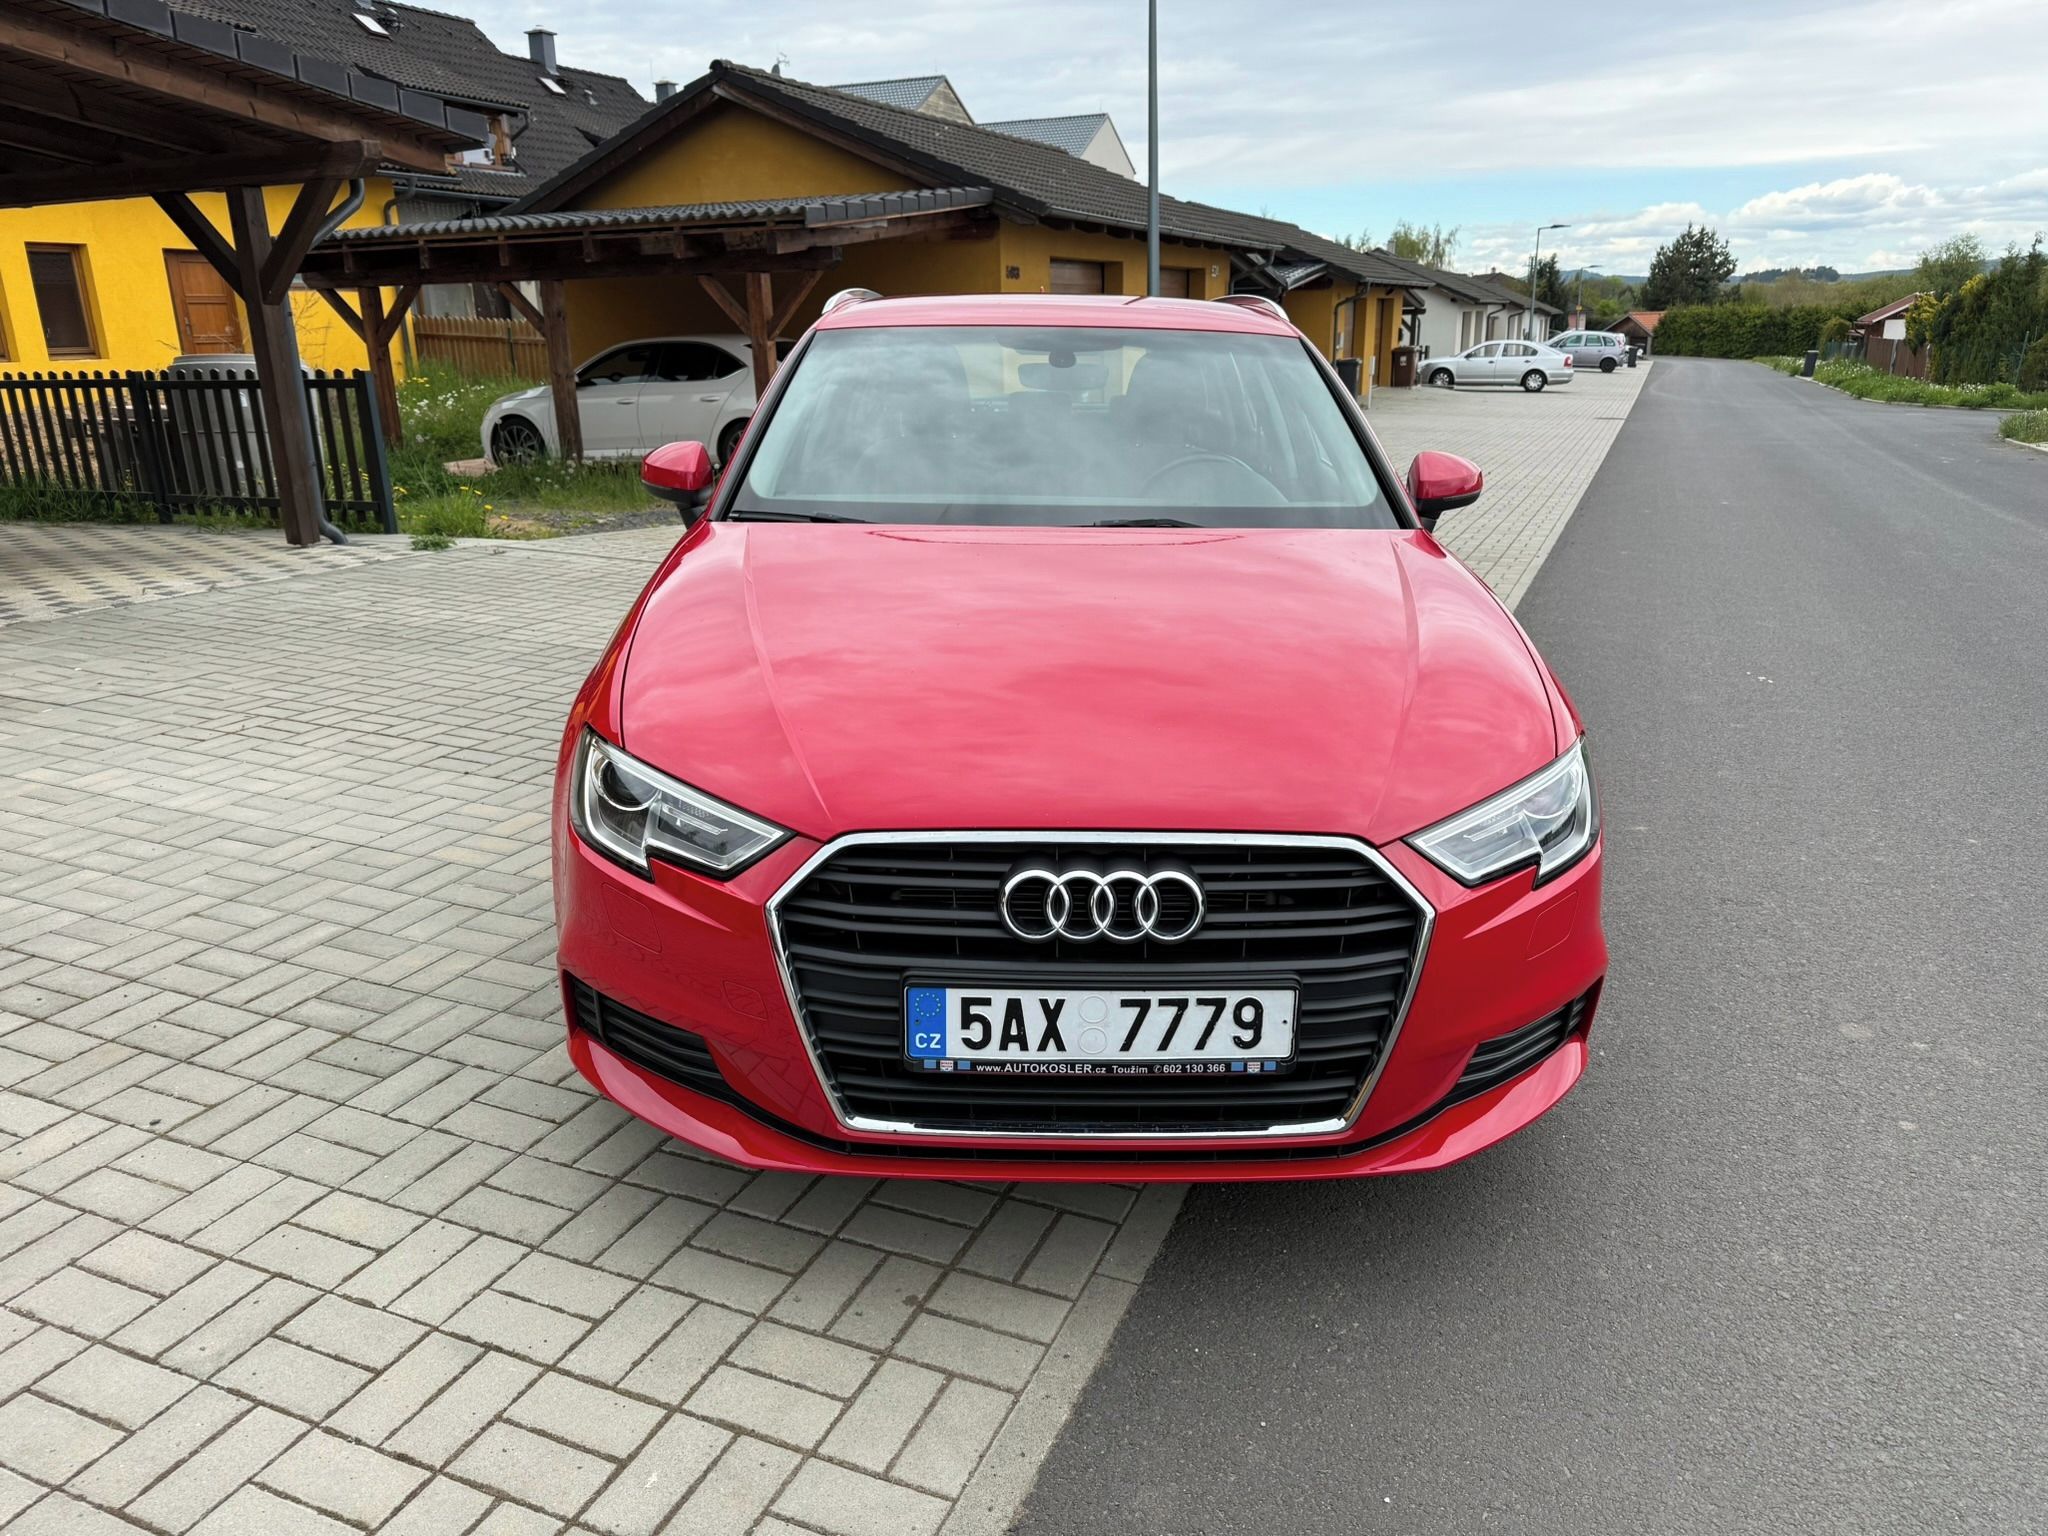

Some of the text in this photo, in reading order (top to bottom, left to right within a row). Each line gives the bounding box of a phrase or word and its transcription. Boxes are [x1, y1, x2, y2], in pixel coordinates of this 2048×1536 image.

[960, 997, 1264, 1052] 5AX 7779
[914, 1033, 941, 1049] CZ
[976, 1063, 1107, 1074] www.AUTOKOSLER.cz
[1185, 1063, 1204, 1073] 130
[1207, 1063, 1226, 1072] 366
